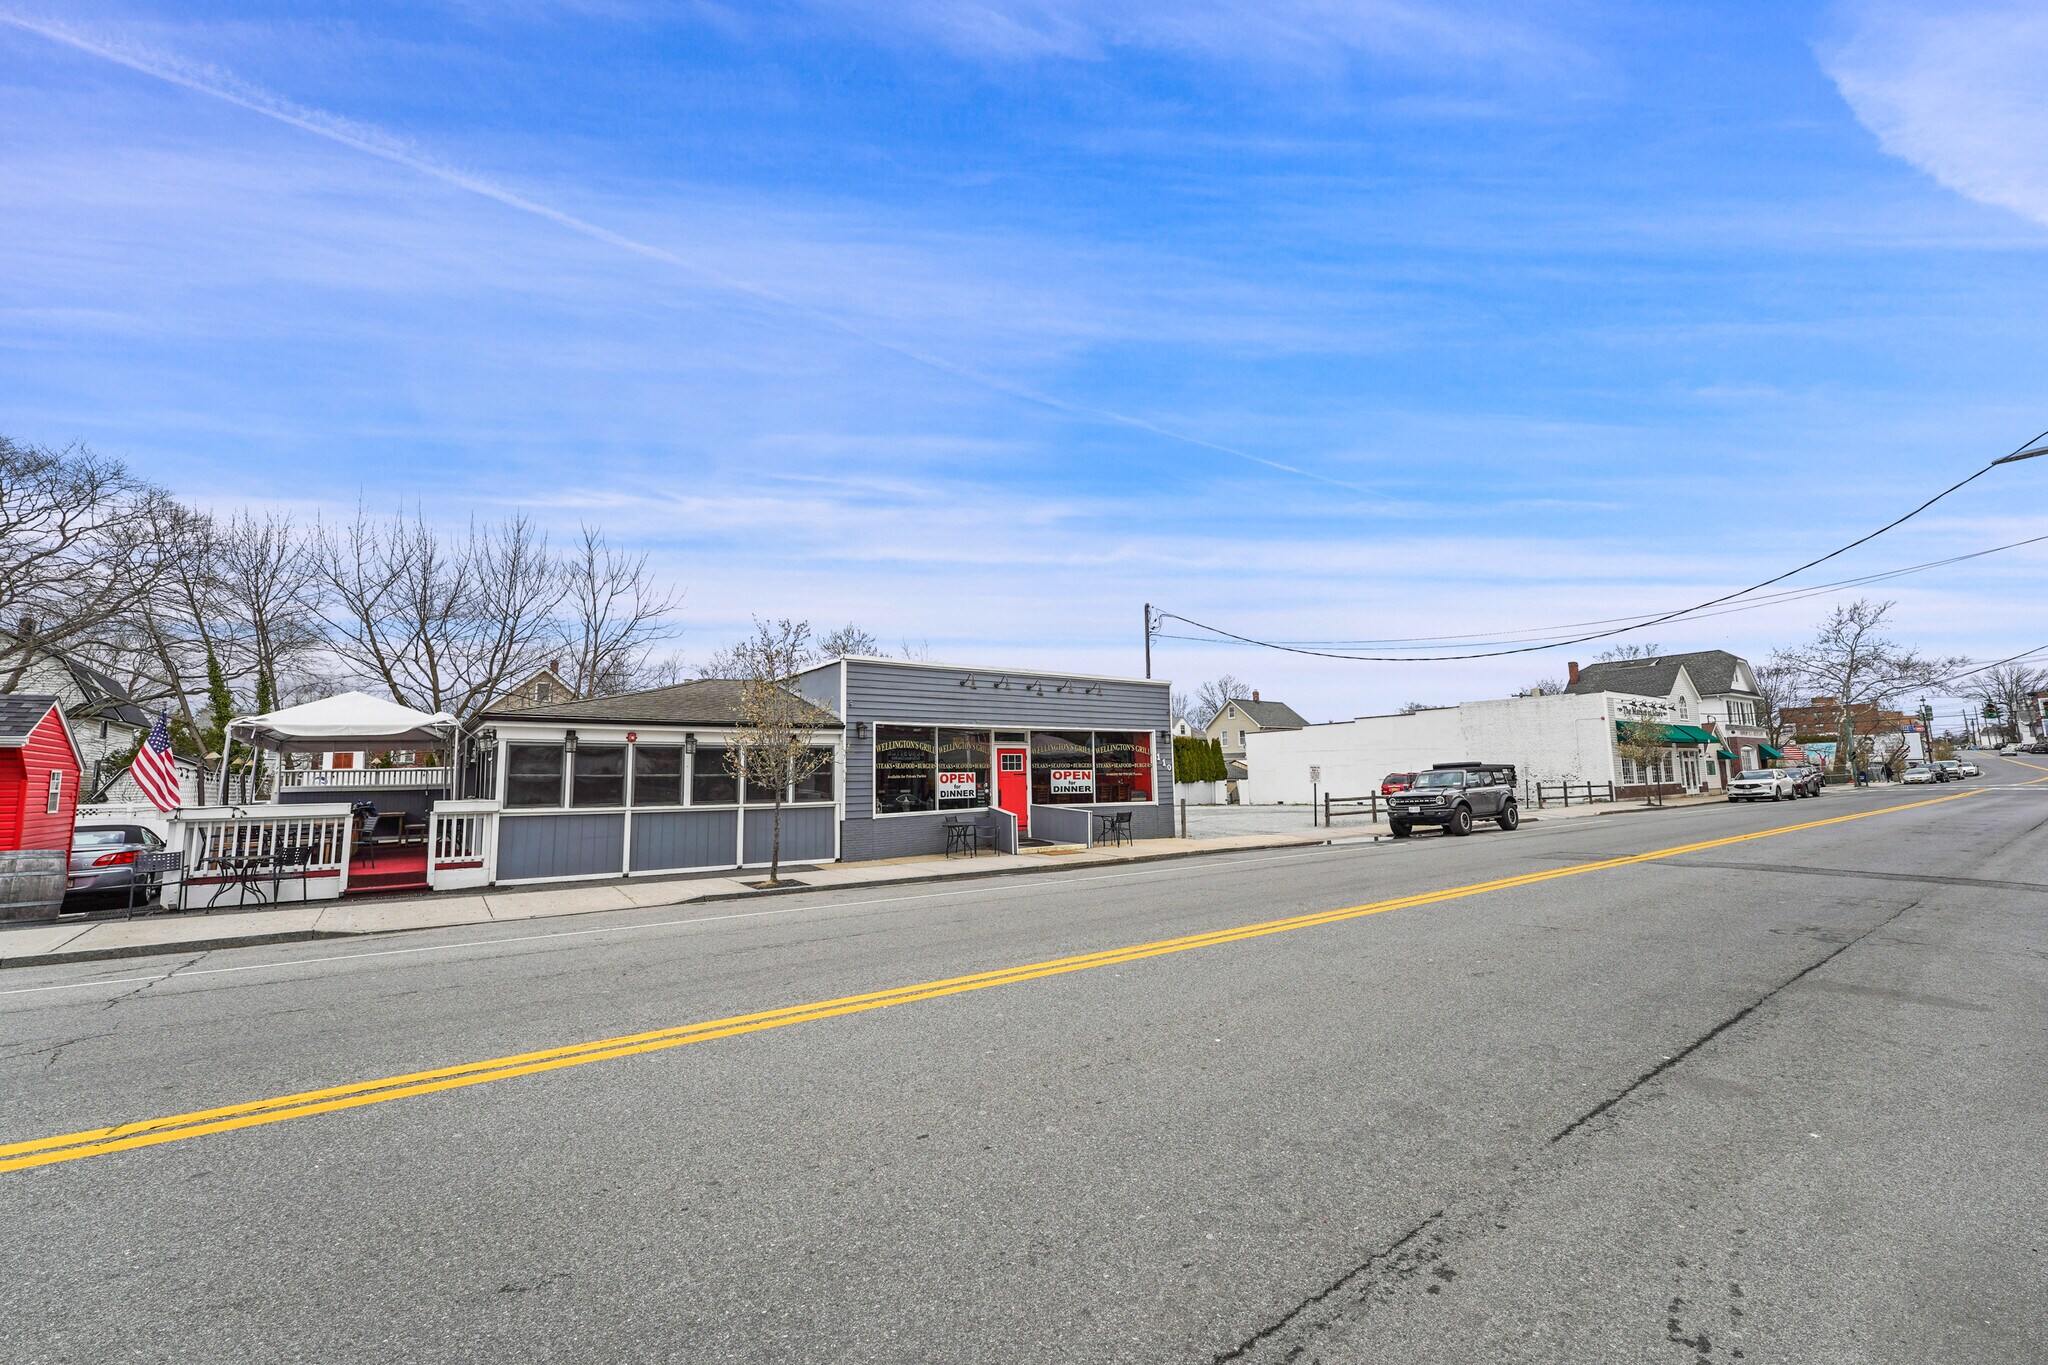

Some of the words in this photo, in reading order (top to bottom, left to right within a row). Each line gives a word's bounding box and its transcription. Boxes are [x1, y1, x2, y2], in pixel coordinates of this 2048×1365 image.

[876, 740, 918, 752] WELLINGTON'S
[919, 742, 937, 755] GRILL
[1095, 743, 1135, 754] WELLINGTON'S
[1135, 745, 1151, 756] GRILL
[939, 773, 975, 784] OPEN
[1052, 771, 1091, 780] OPEN
[940, 789, 975, 798] DINNER
[1053, 785, 1092, 793] DINNER
